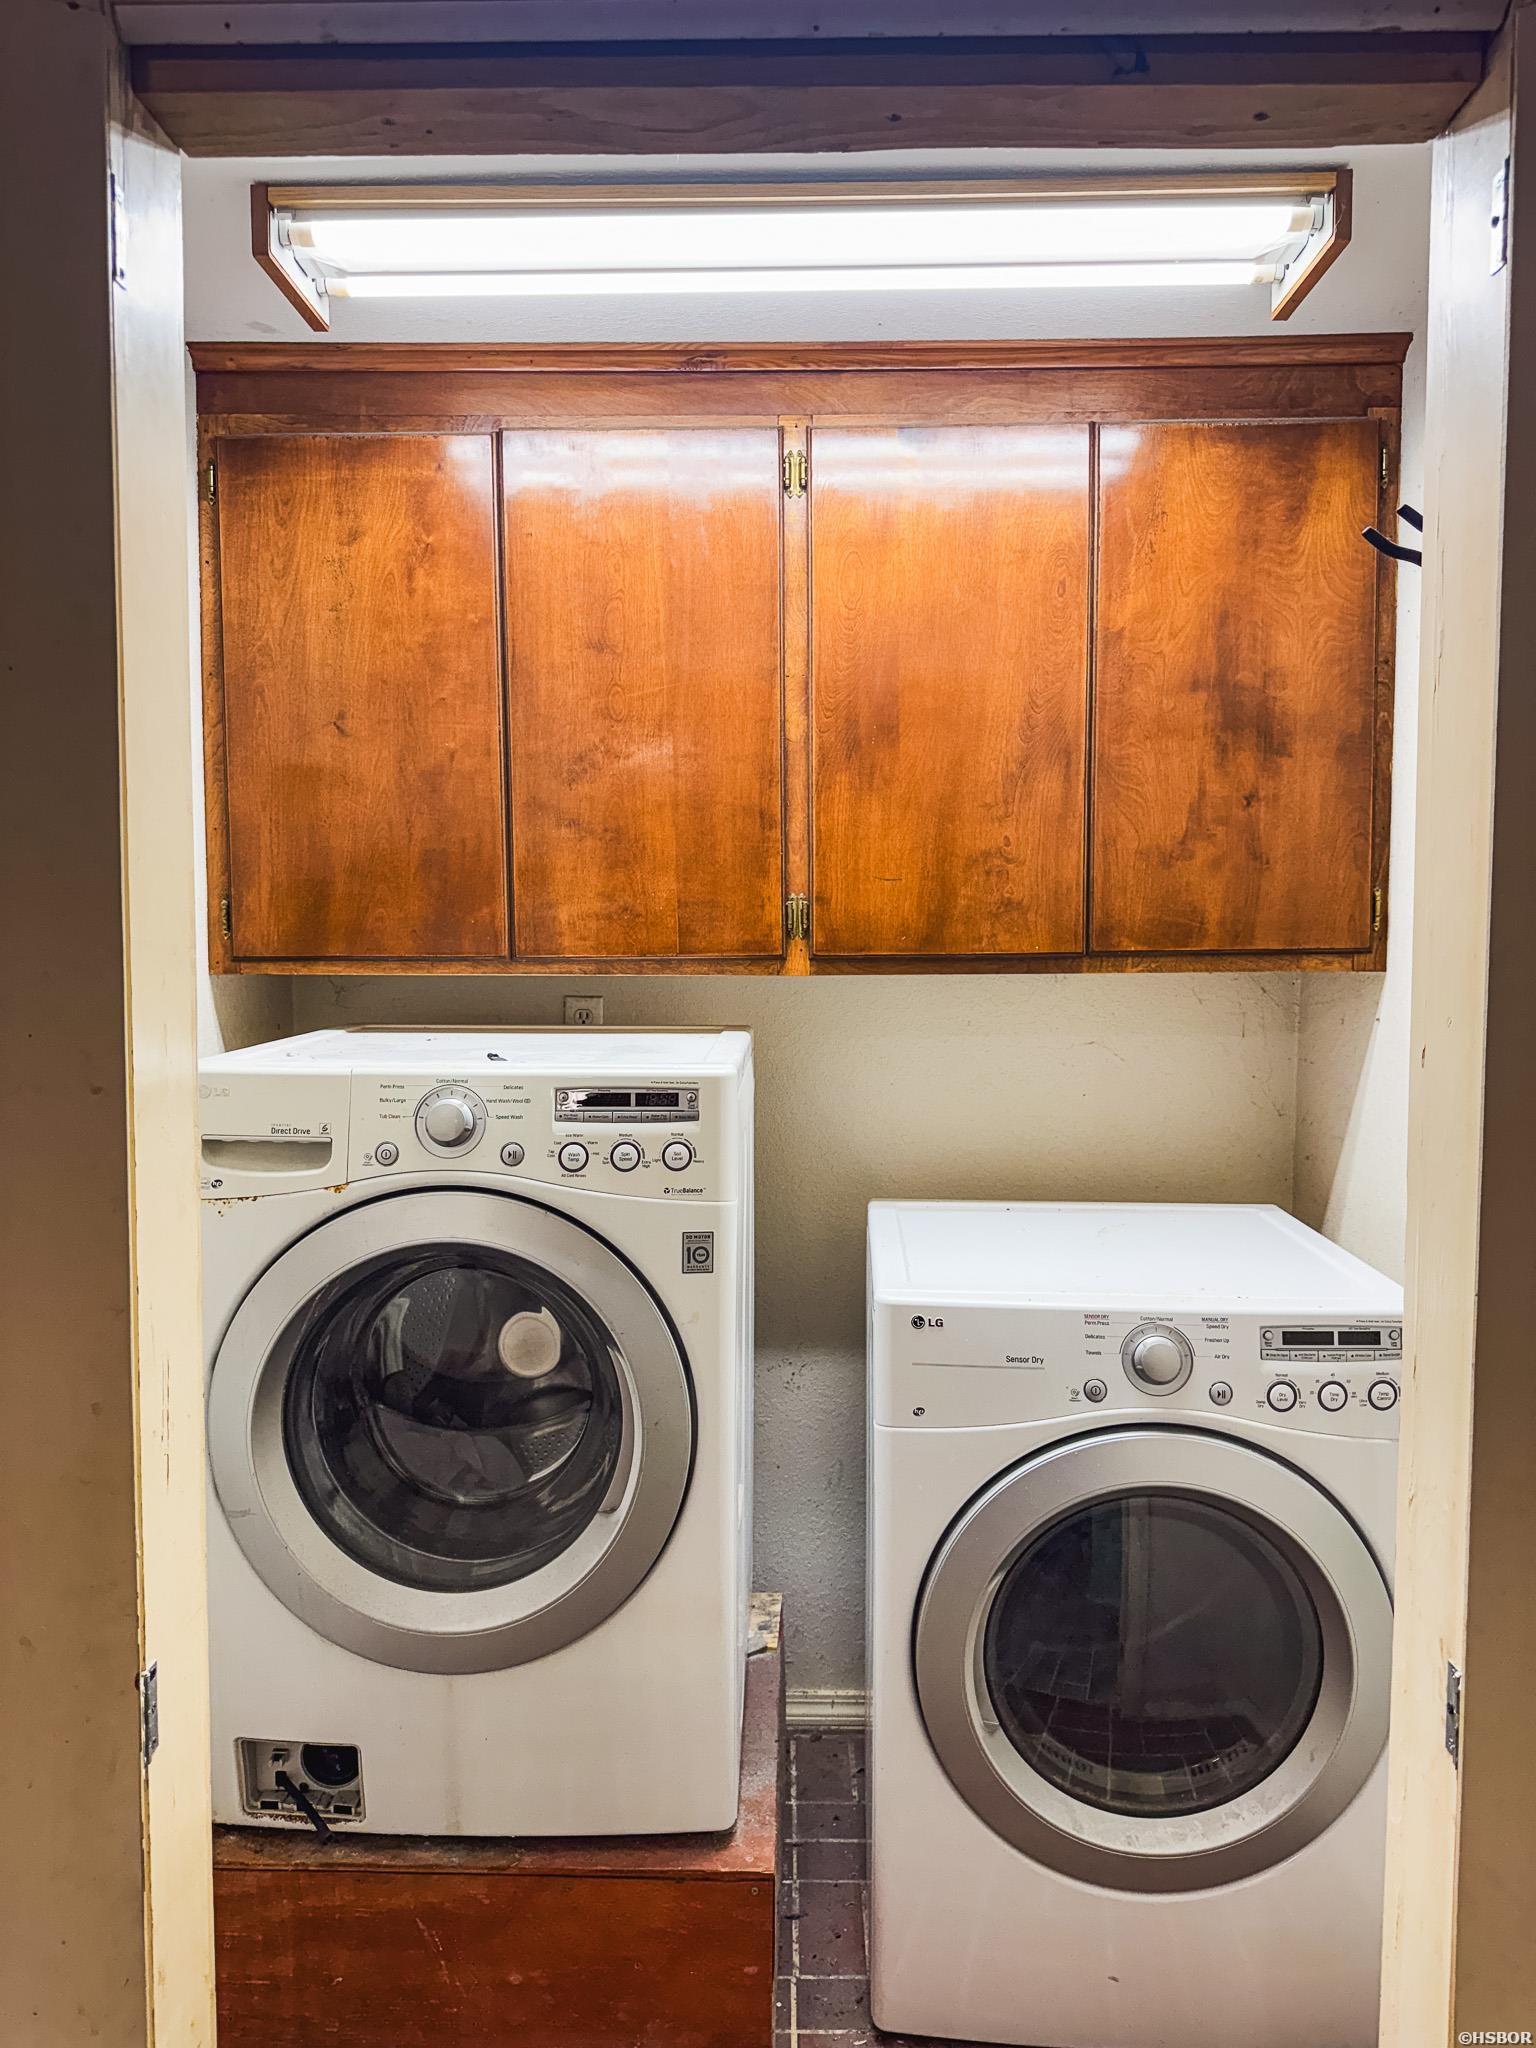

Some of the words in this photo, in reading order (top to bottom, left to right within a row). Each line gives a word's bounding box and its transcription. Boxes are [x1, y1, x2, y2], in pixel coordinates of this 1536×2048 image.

[271, 1127, 291, 1135] Direct
[292, 1127, 311, 1135] Drive
[686, 1246, 710, 1264] 10
[928, 1318, 944, 1327] LG
[1005, 1355, 1030, 1363] Sensor
[1031, 1356, 1044, 1365] Dry
